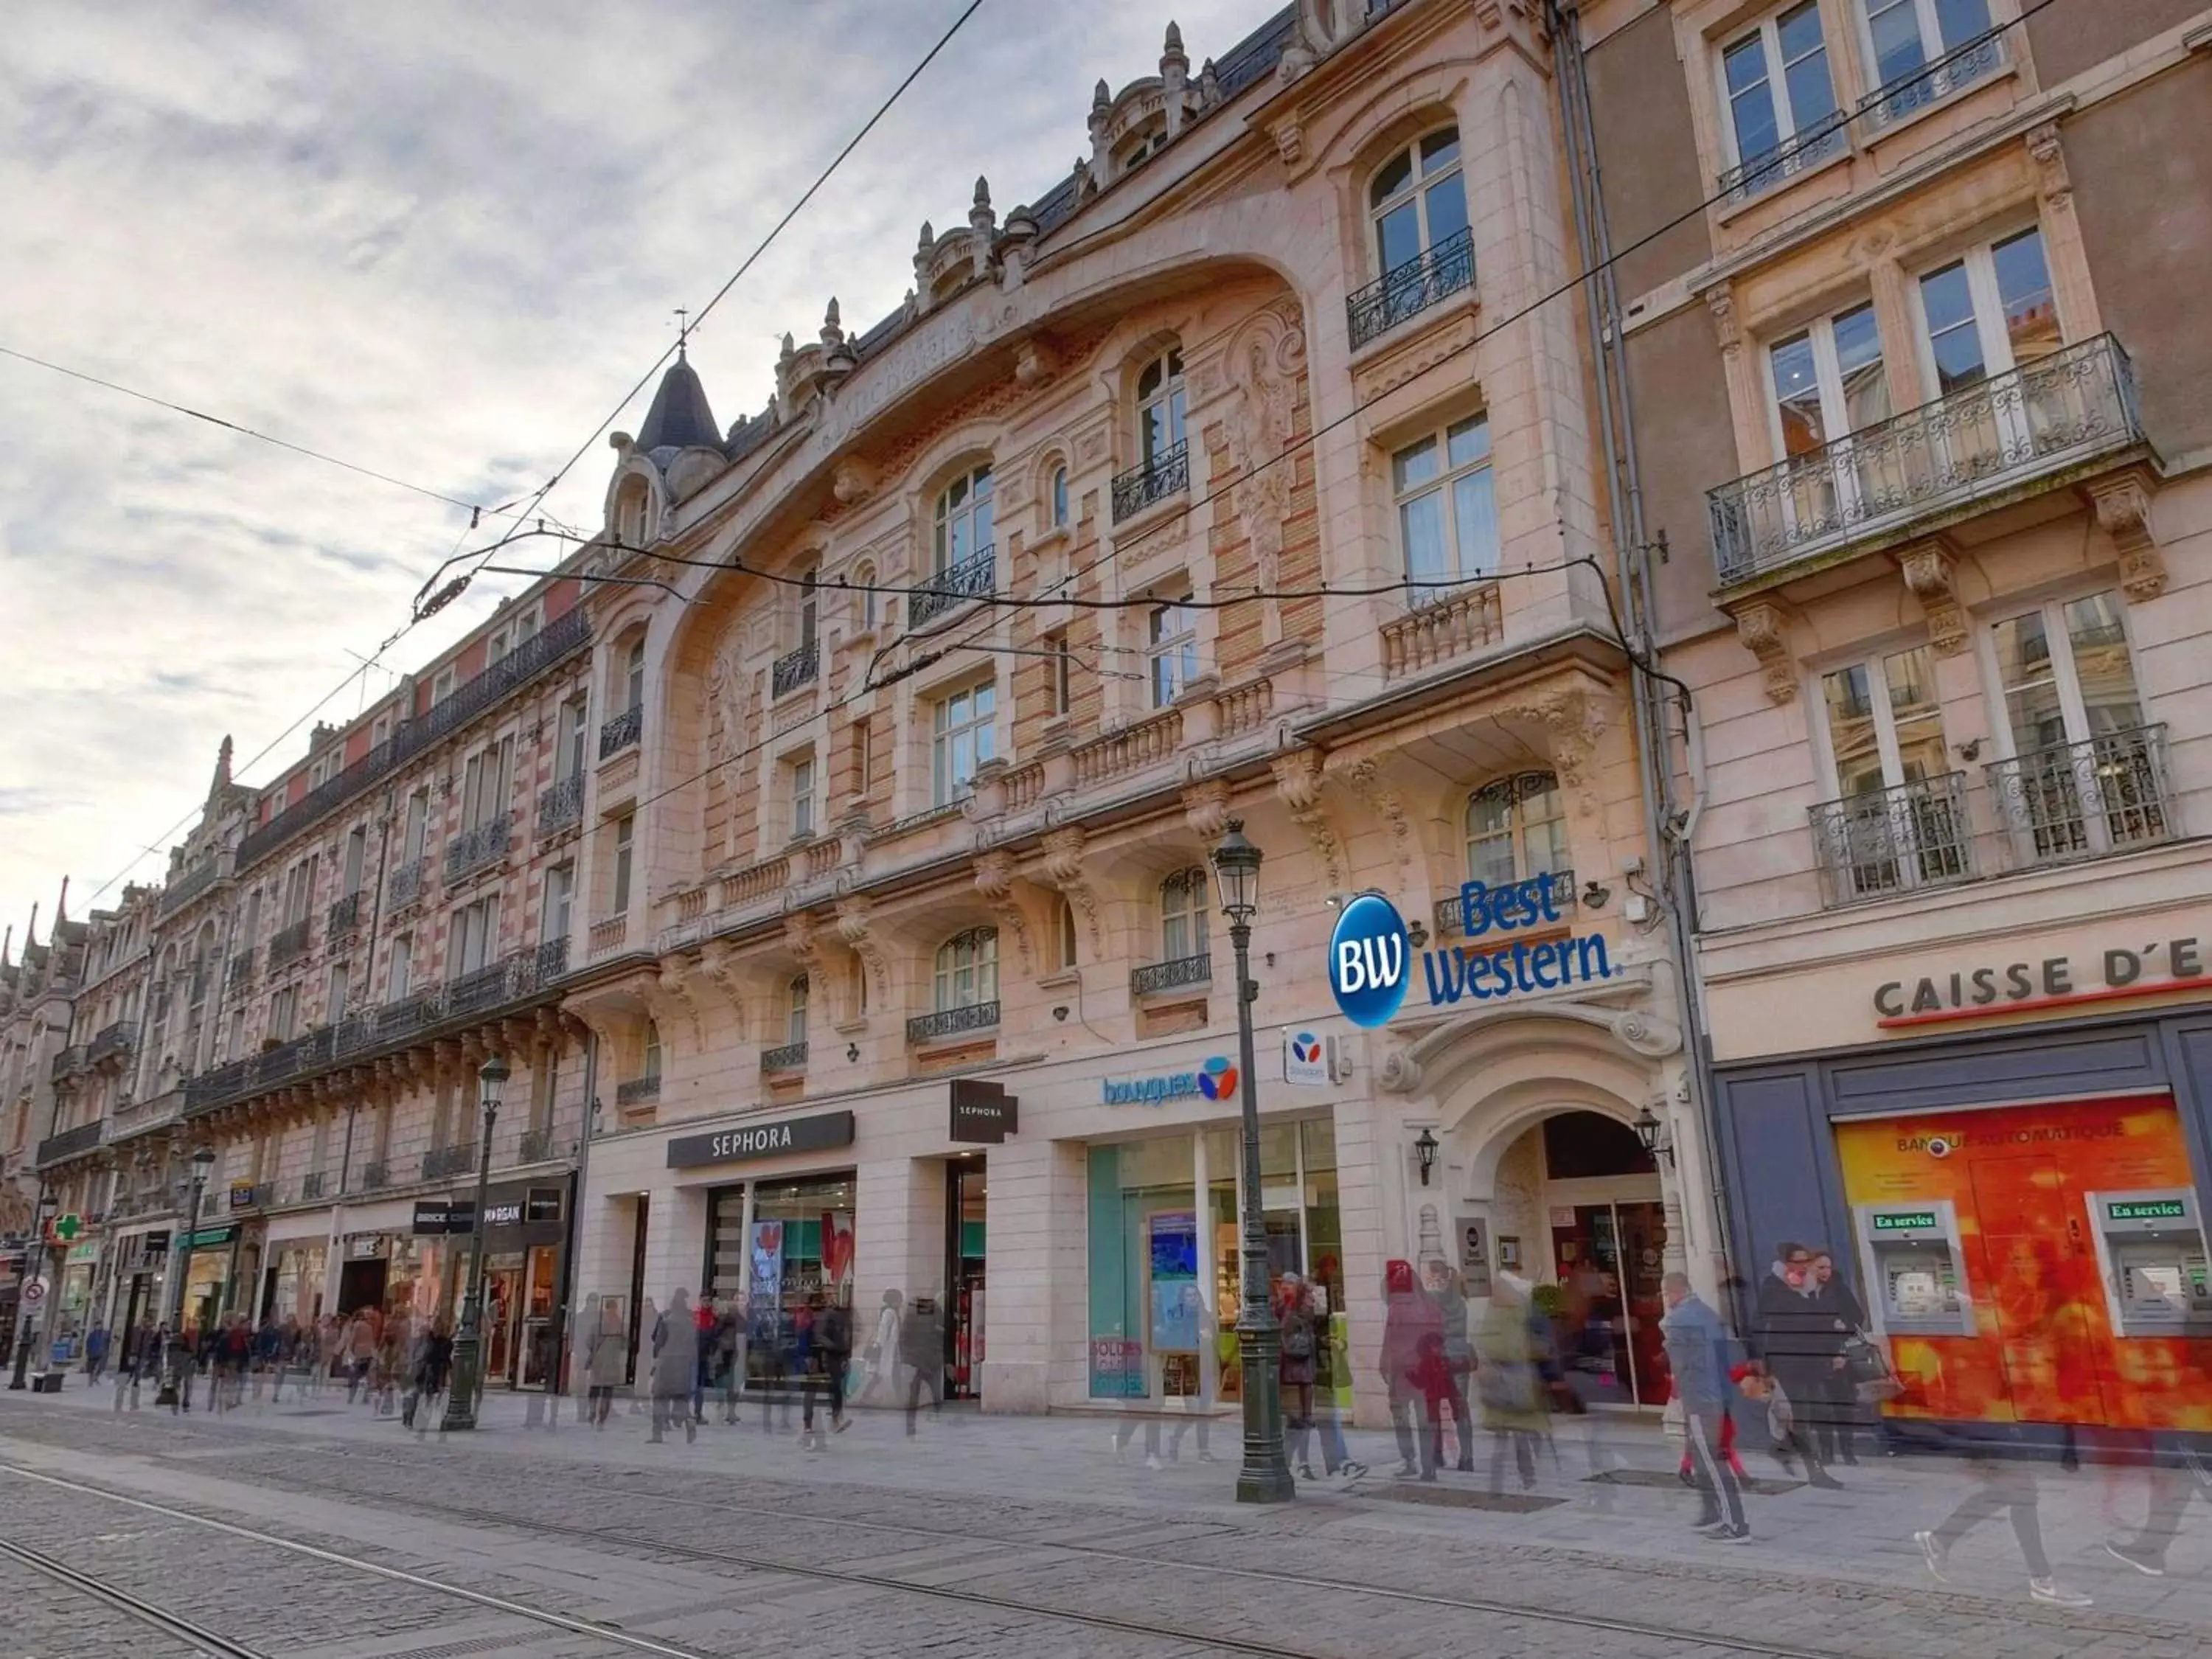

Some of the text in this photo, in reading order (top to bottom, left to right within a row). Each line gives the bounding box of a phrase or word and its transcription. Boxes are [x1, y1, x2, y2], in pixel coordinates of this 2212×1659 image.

[1461, 872, 1560, 937] Best
[1338, 932, 1402, 994] BW
[1423, 933, 1611, 1006] Western
[1873, 956, 2073, 1017] CAISSE
[959, 1106, 1002, 1116] SEPHORA
[712, 1126, 792, 1157] SEPHORA
[1876, 1215, 1934, 1227] En service
[2111, 1203, 2182, 1217] En service
